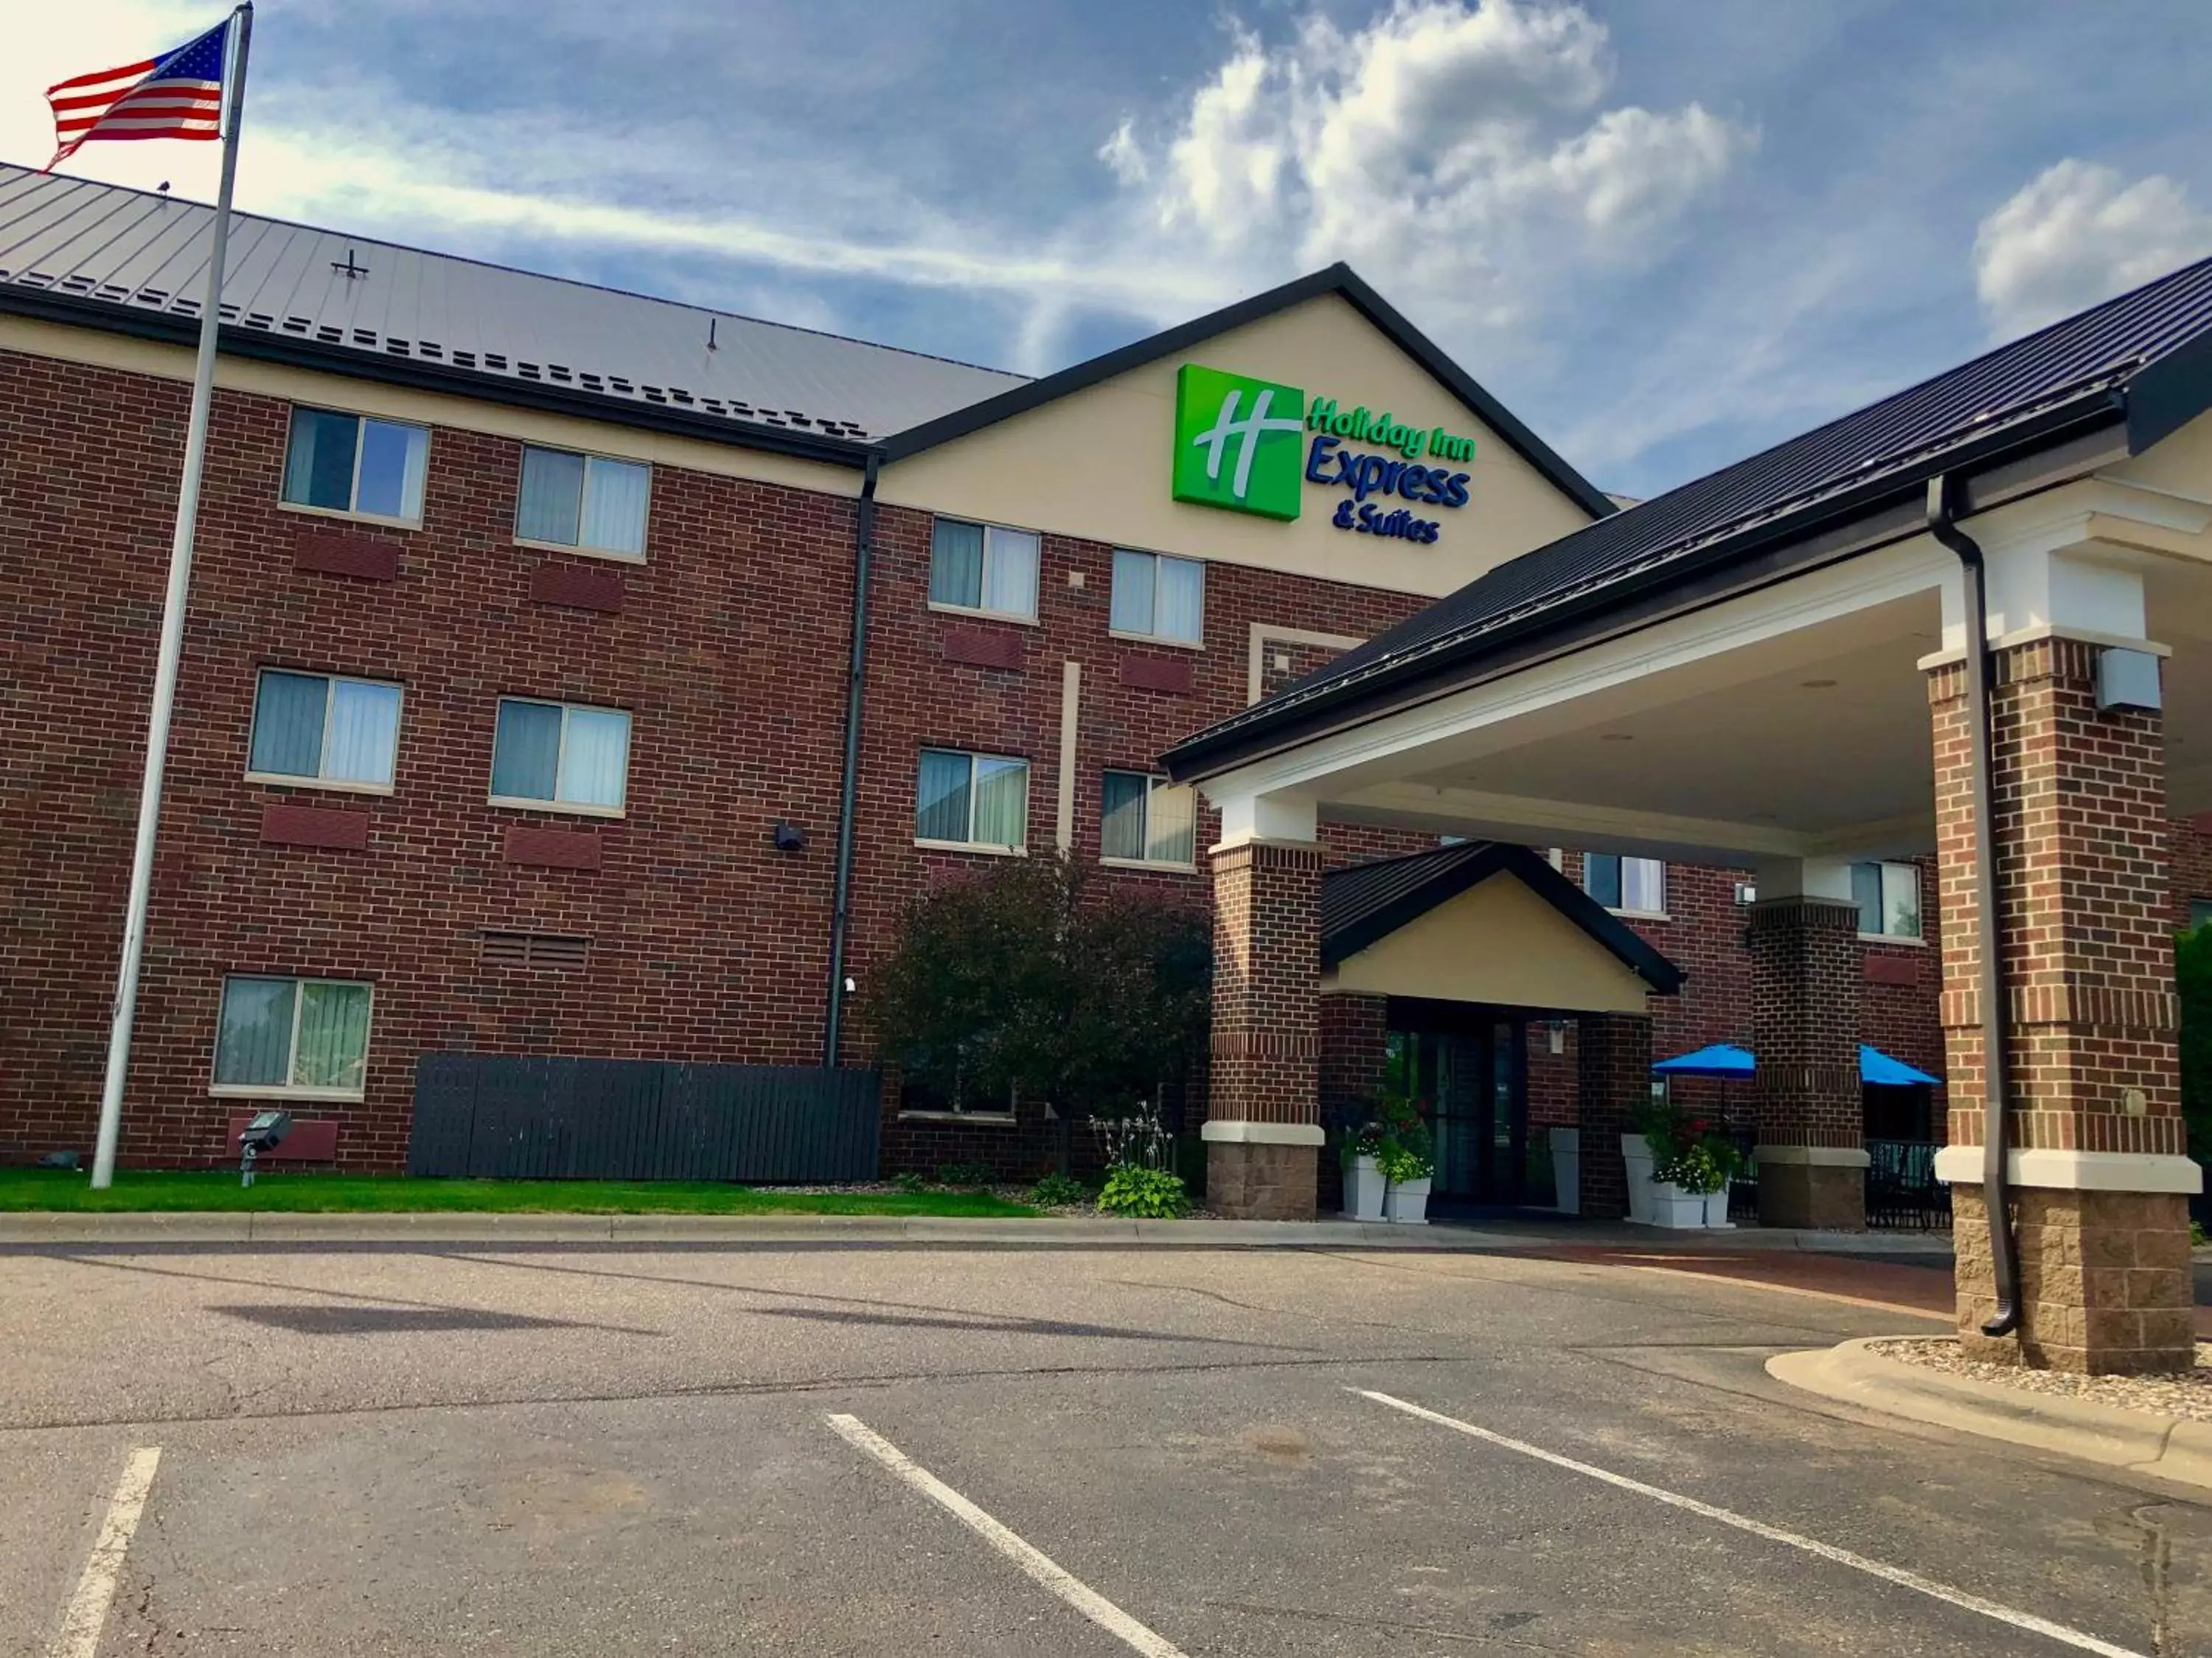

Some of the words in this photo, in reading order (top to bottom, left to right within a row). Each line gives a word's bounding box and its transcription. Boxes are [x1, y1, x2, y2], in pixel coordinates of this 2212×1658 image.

[1193, 389, 1303, 498] H
[1307, 396, 1426, 459] Holiday
[1429, 426, 1475, 462] Inn
[1305, 435, 1471, 507] Express
